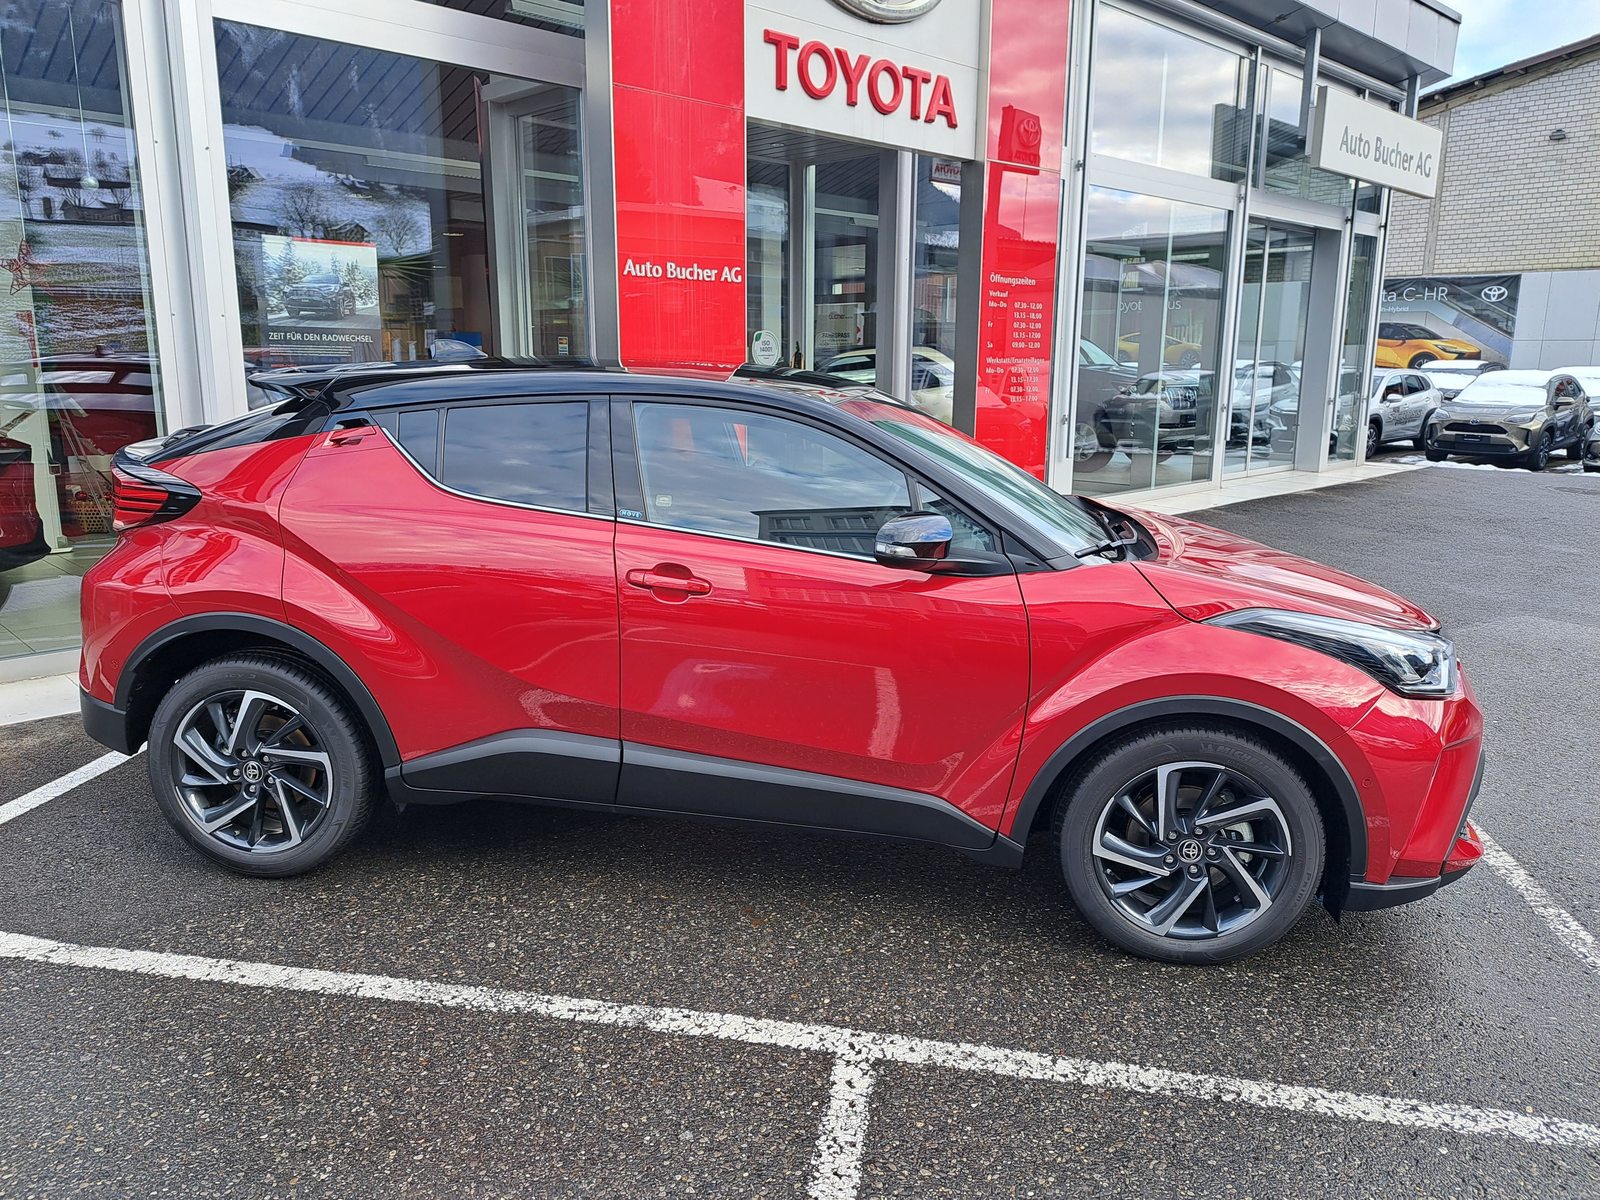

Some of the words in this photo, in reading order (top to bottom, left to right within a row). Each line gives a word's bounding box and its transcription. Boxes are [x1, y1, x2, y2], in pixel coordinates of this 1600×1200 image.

[763, 28, 958, 129] TOYOTA
[1339, 125, 1370, 159] Auto
[1373, 136, 1414, 172] Bucher
[1415, 151, 1432, 178] AG
[623, 259, 663, 278] Auto
[666, 261, 718, 281] Bucher
[720, 266, 742, 283] AG
[990, 272, 1036, 287] Öffnungszeiten
[989, 290, 1009, 298] Verkauf
[1403, 287, 1448, 301] C-HR
[268, 332, 285, 341] ZEIT
[286, 331, 302, 341] FÜR
[303, 333, 320, 342] DEN
[321, 333, 374, 344] RADWECHSEL
